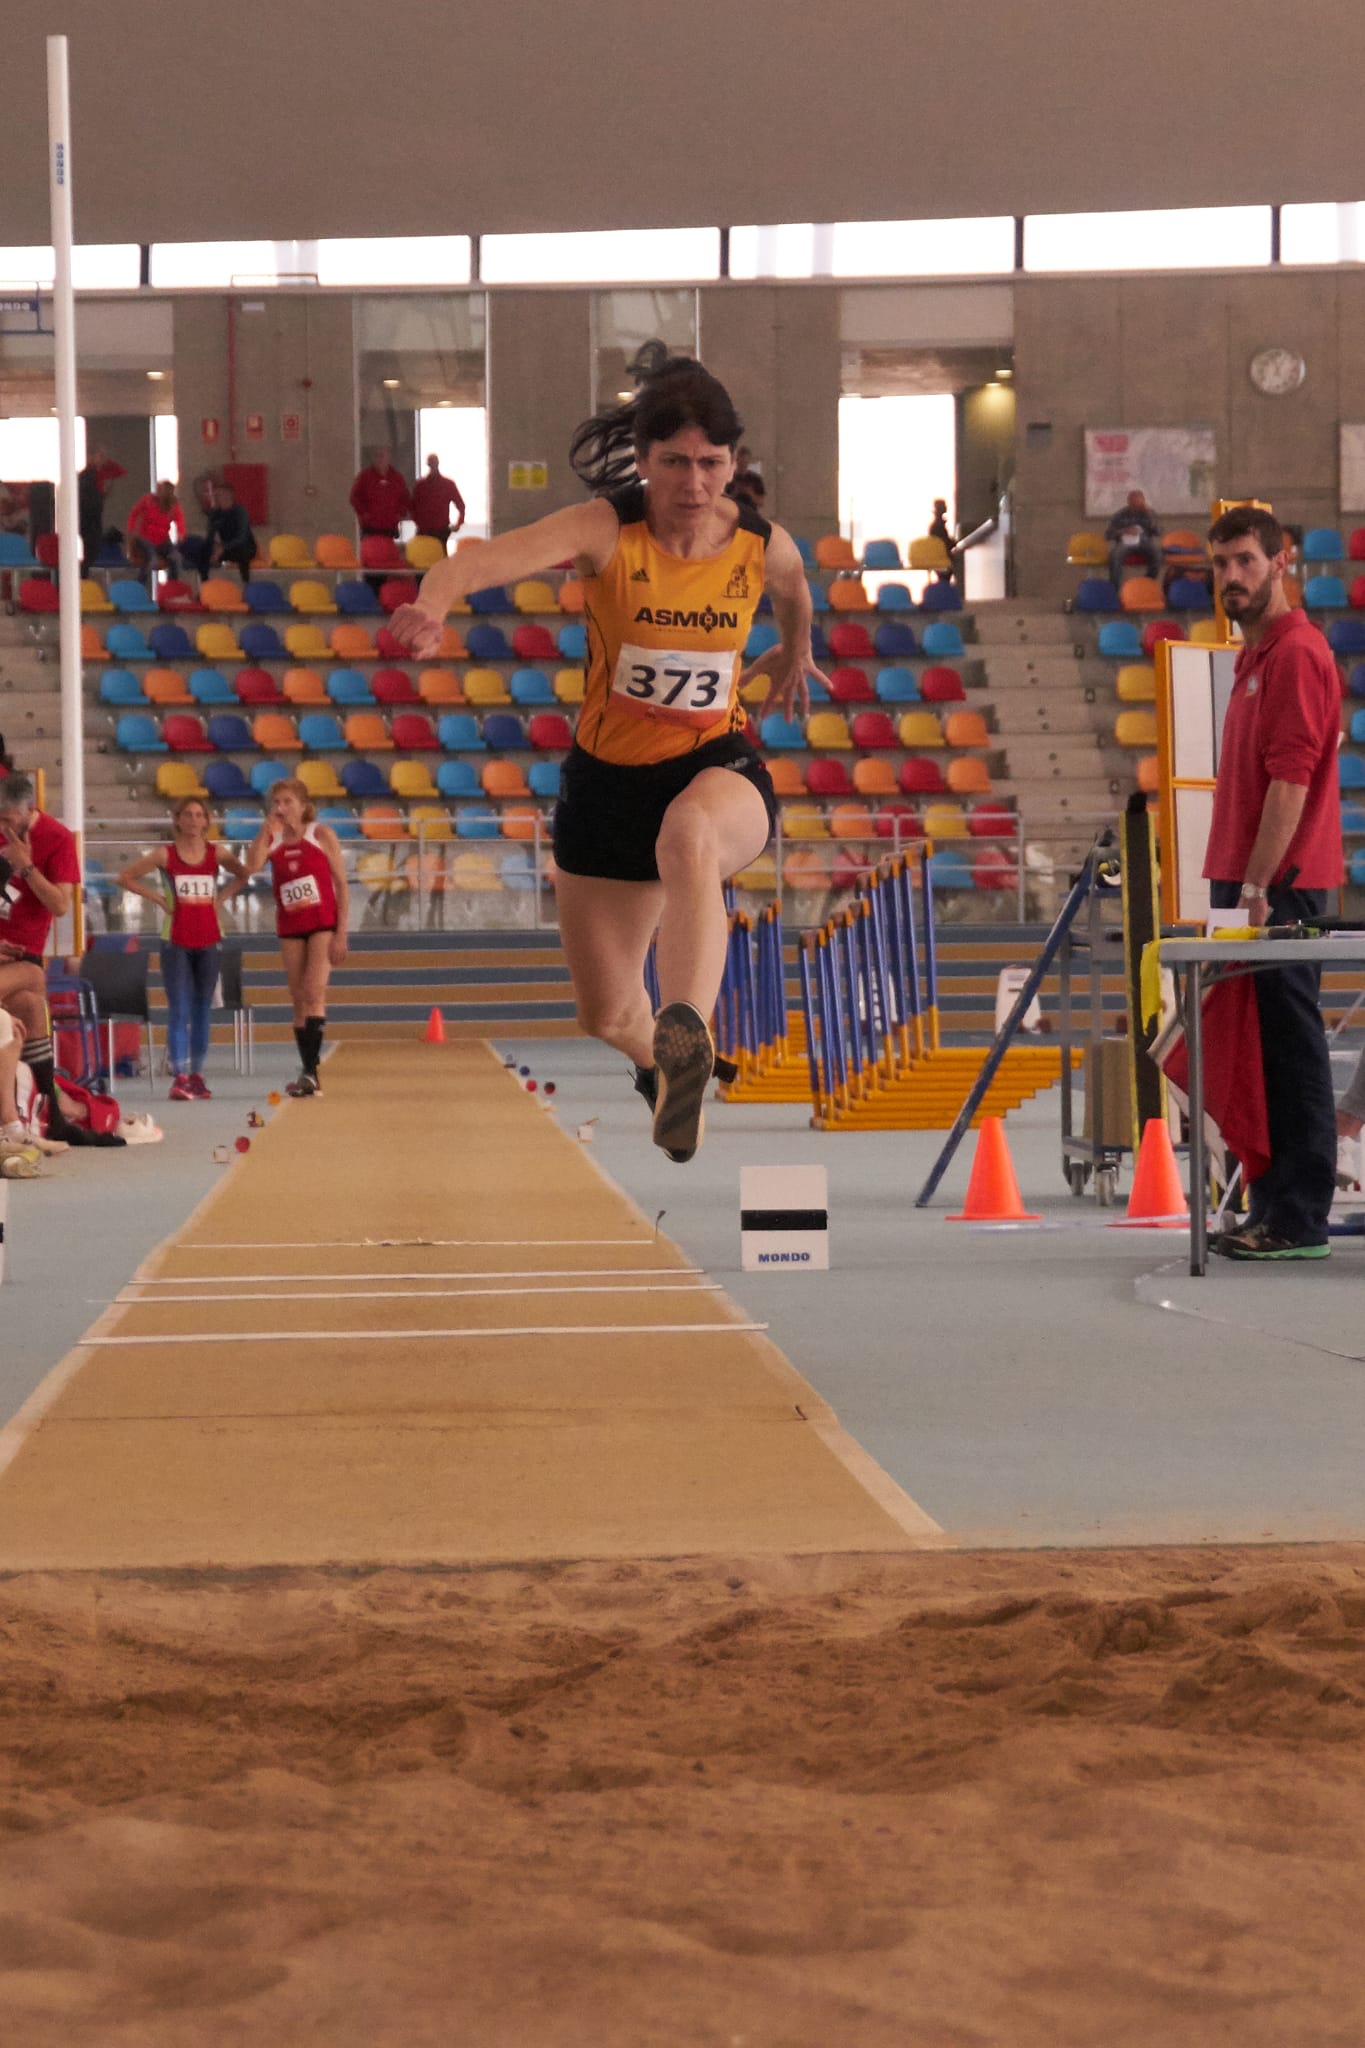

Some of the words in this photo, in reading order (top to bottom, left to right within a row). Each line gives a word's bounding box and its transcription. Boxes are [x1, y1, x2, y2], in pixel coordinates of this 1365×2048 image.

[634, 604, 738, 632] ASMON
[625, 664, 720, 708] 373
[179, 881, 210, 896] 411
[283, 882, 314, 903] 308
[758, 1252, 811, 1263] MONDO
